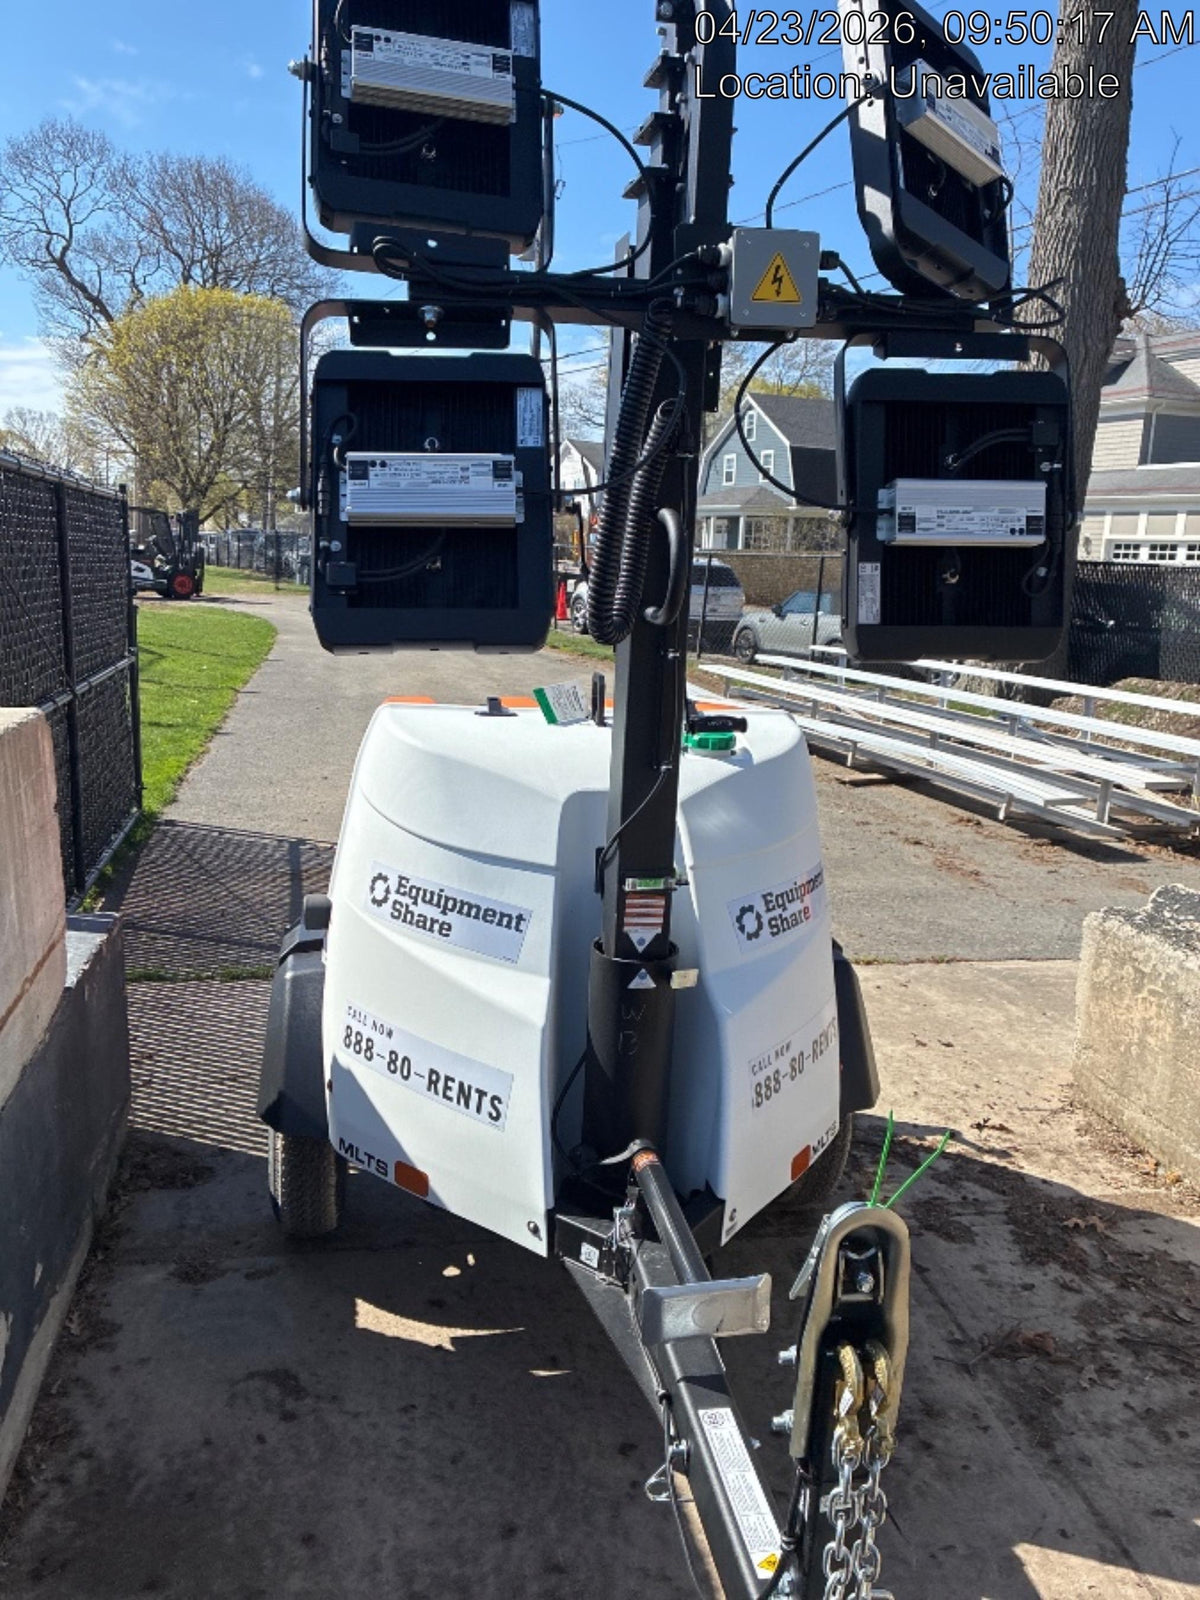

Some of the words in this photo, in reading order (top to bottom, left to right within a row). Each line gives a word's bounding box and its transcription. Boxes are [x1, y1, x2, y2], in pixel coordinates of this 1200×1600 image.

[390, 900, 453, 938] Share
[394, 874, 527, 933] Equipment
[767, 906, 811, 938] Share
[343, 1024, 504, 1123] 888-80-RENTS
[338, 1137, 388, 1178] MLTS
